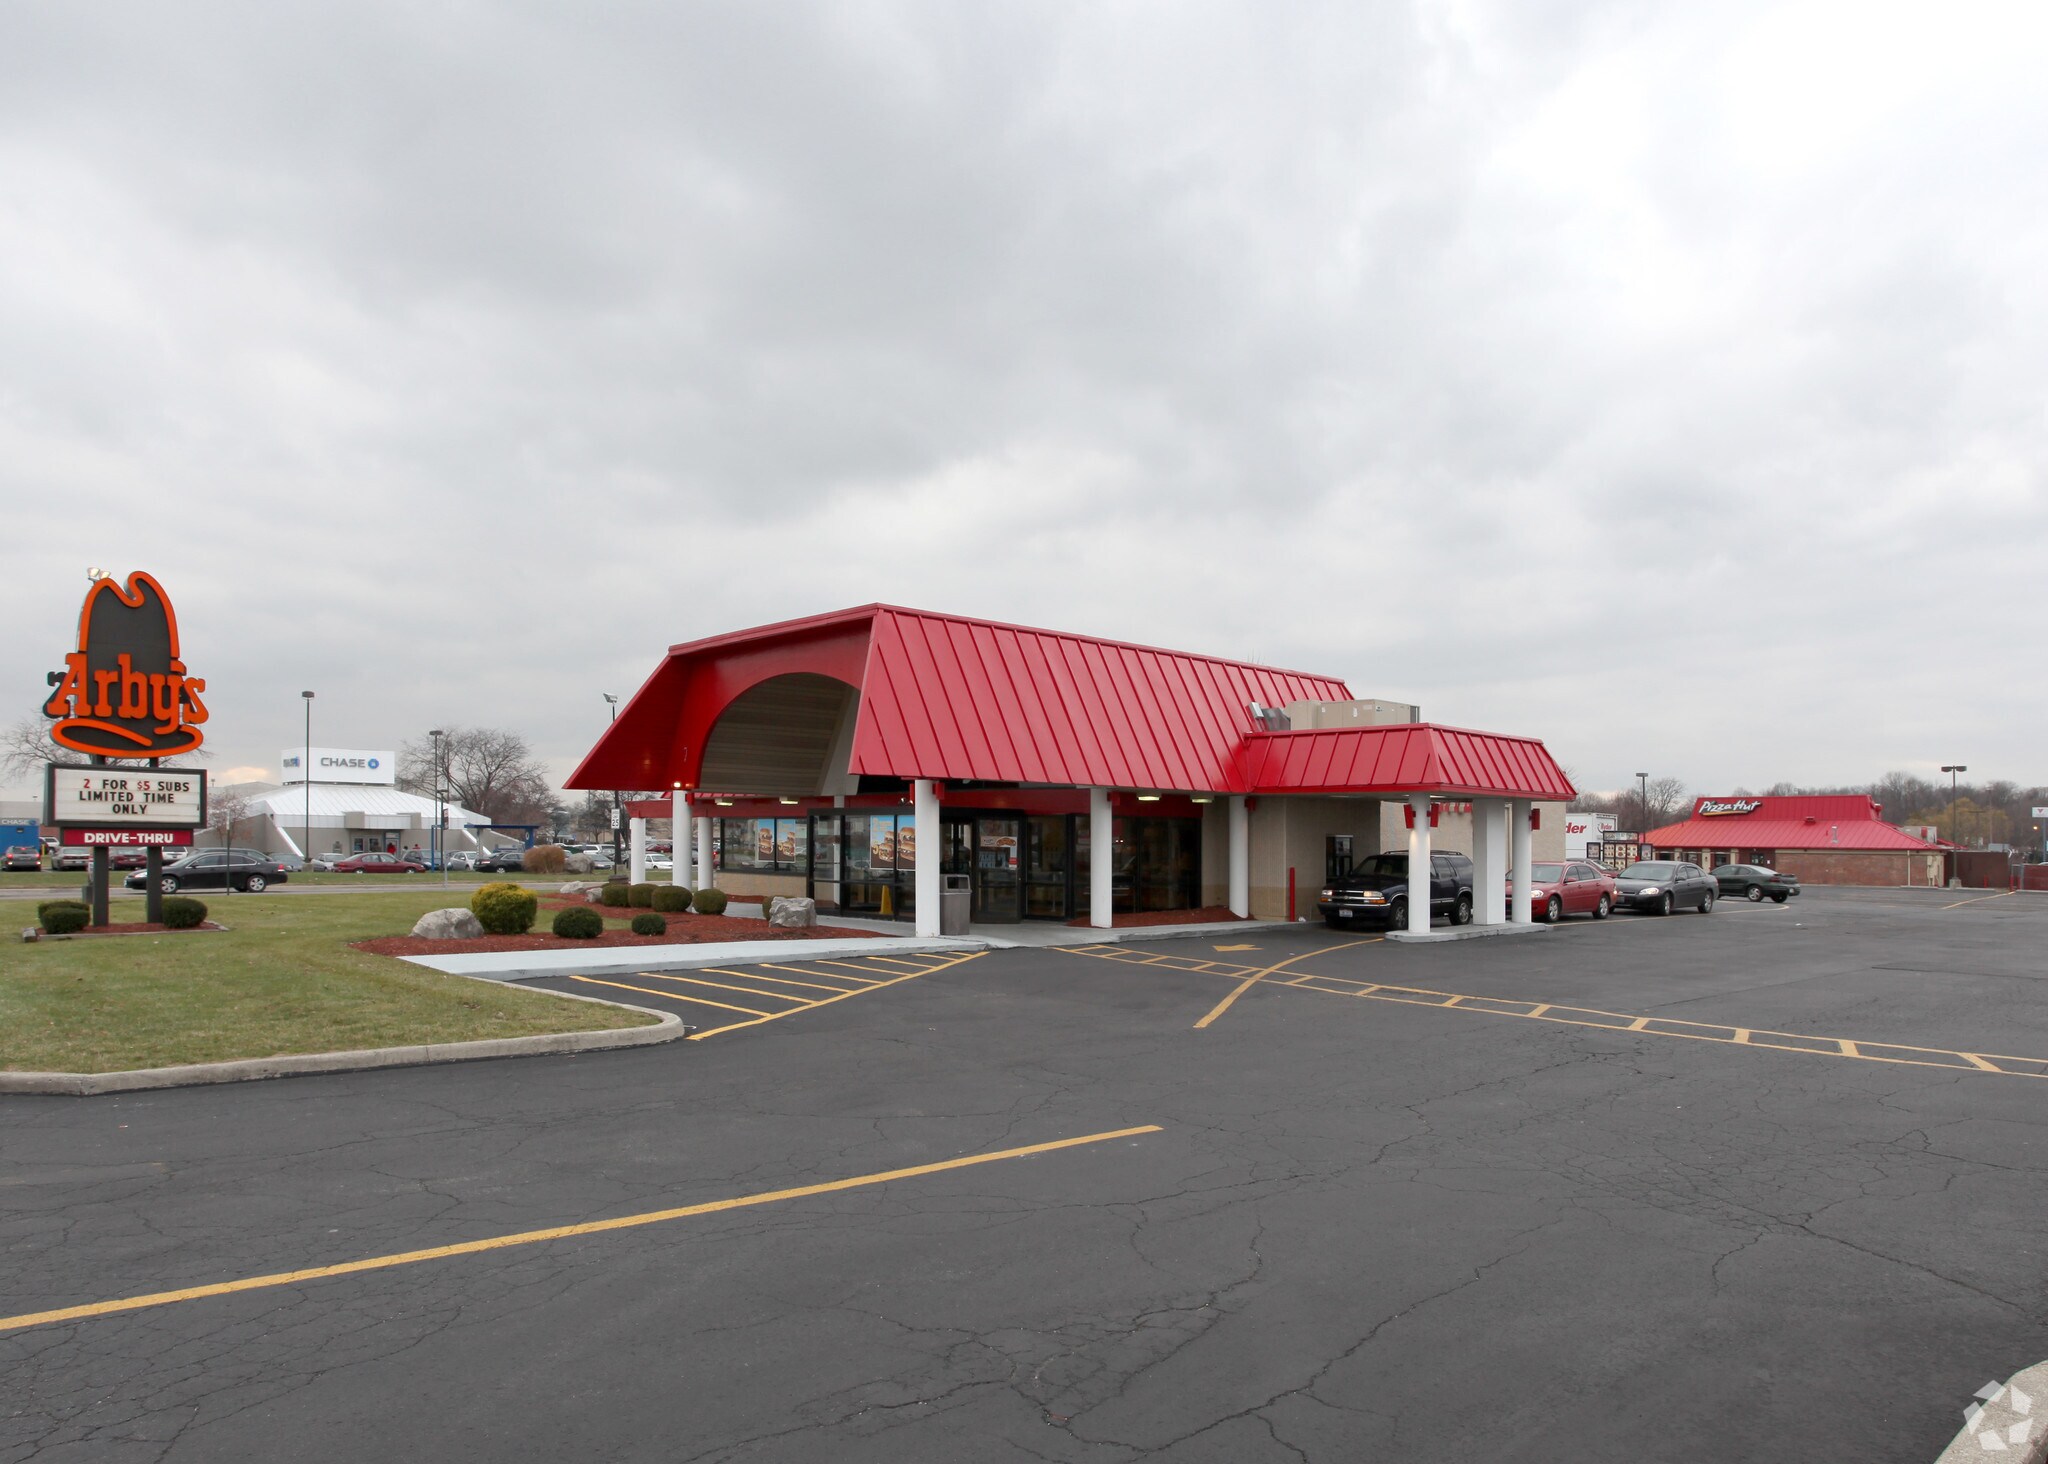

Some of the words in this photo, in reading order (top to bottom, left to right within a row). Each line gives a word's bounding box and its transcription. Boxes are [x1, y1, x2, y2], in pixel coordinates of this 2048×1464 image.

[47, 653, 209, 735] Arby's
[320, 757, 366, 768] CHASE
[83, 778, 91, 789] 2
[102, 779, 127, 790] FOR
[137, 781, 150, 791] $5
[157, 781, 189, 792] SUBS
[79, 790, 134, 802] LIMITED
[144, 792, 174, 803] TIME
[112, 804, 147, 815] ONLY
[1698, 800, 1732, 813] Pizza
[1732, 799, 1761, 811] Hut
[84, 832, 174, 844] DRIVE-THRU
